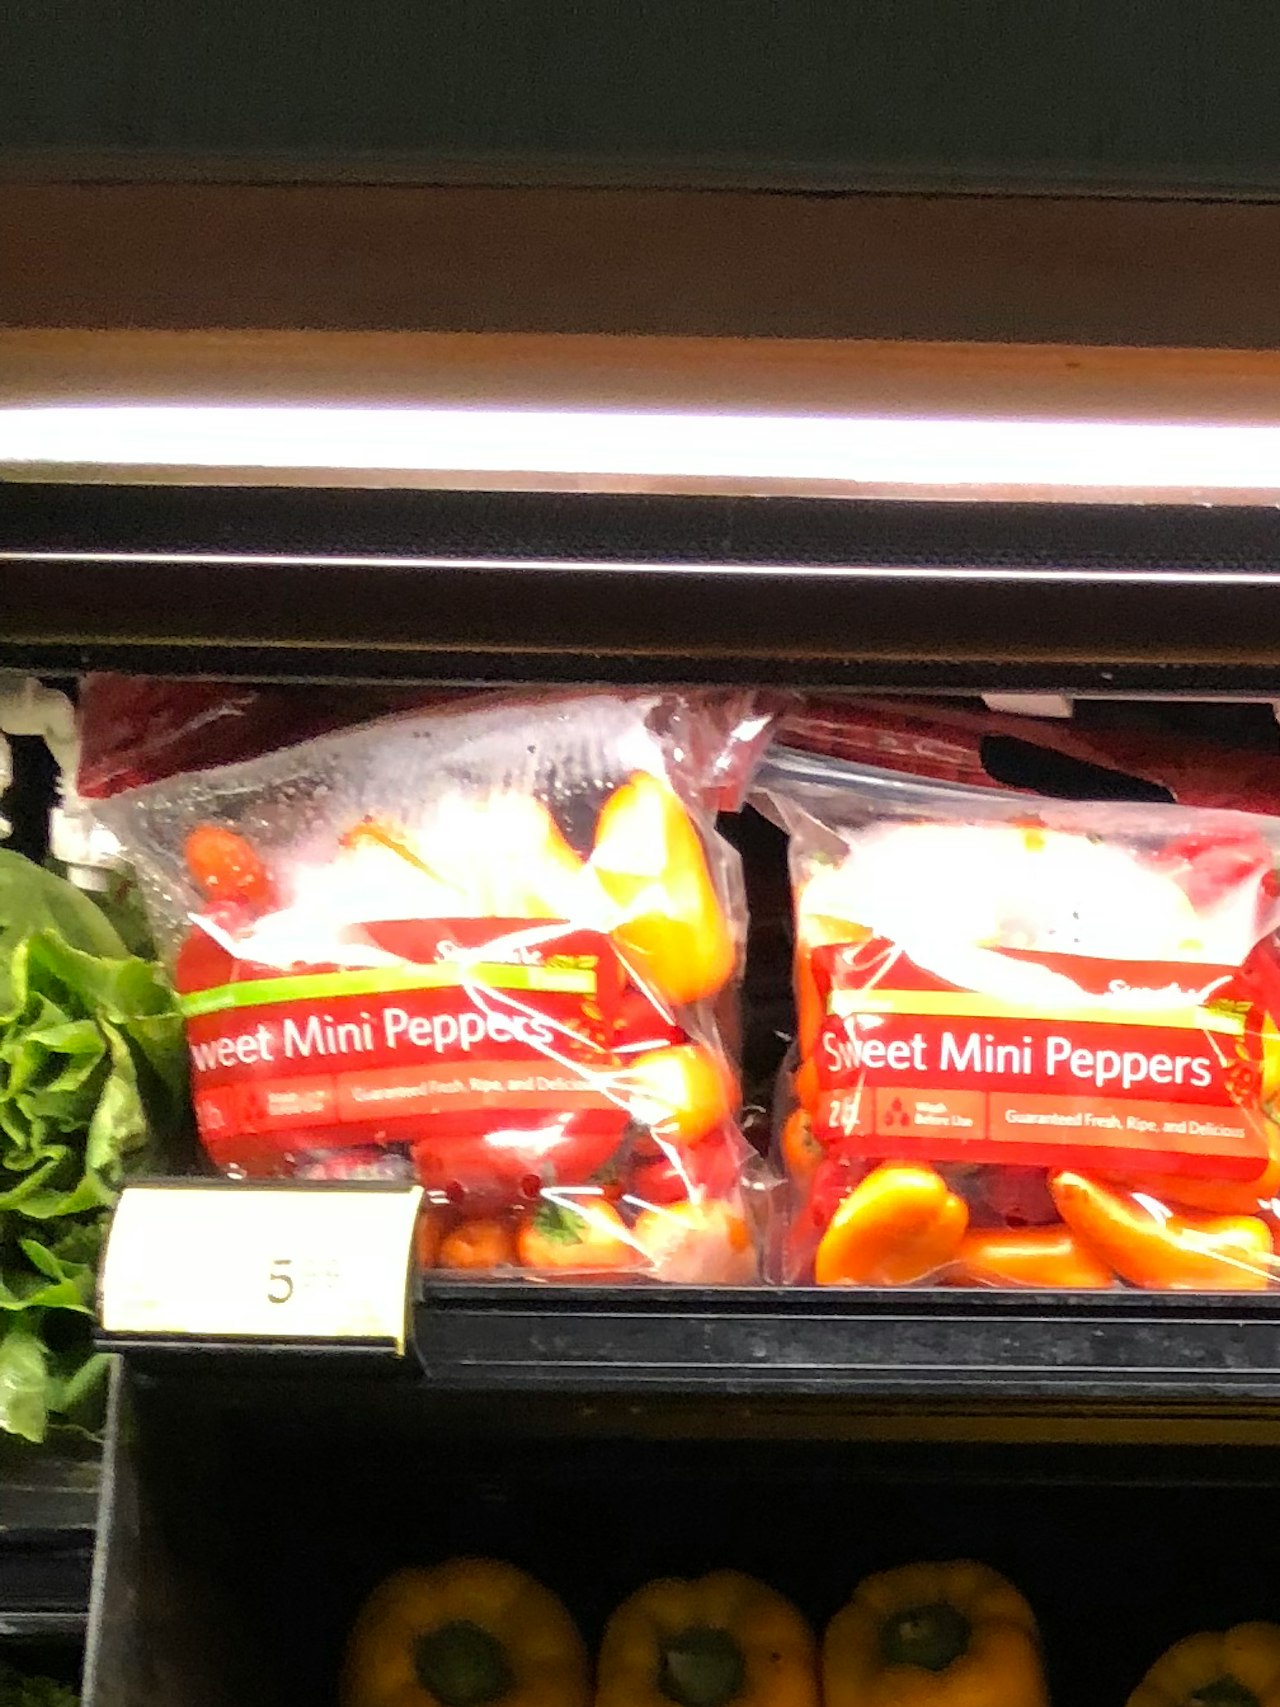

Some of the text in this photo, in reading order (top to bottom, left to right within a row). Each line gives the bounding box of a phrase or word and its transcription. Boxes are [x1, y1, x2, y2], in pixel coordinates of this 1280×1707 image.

[190, 1006, 554, 1072] weet Mini Peppers
[823, 1029, 1213, 1090] Sweet Mini Peppers
